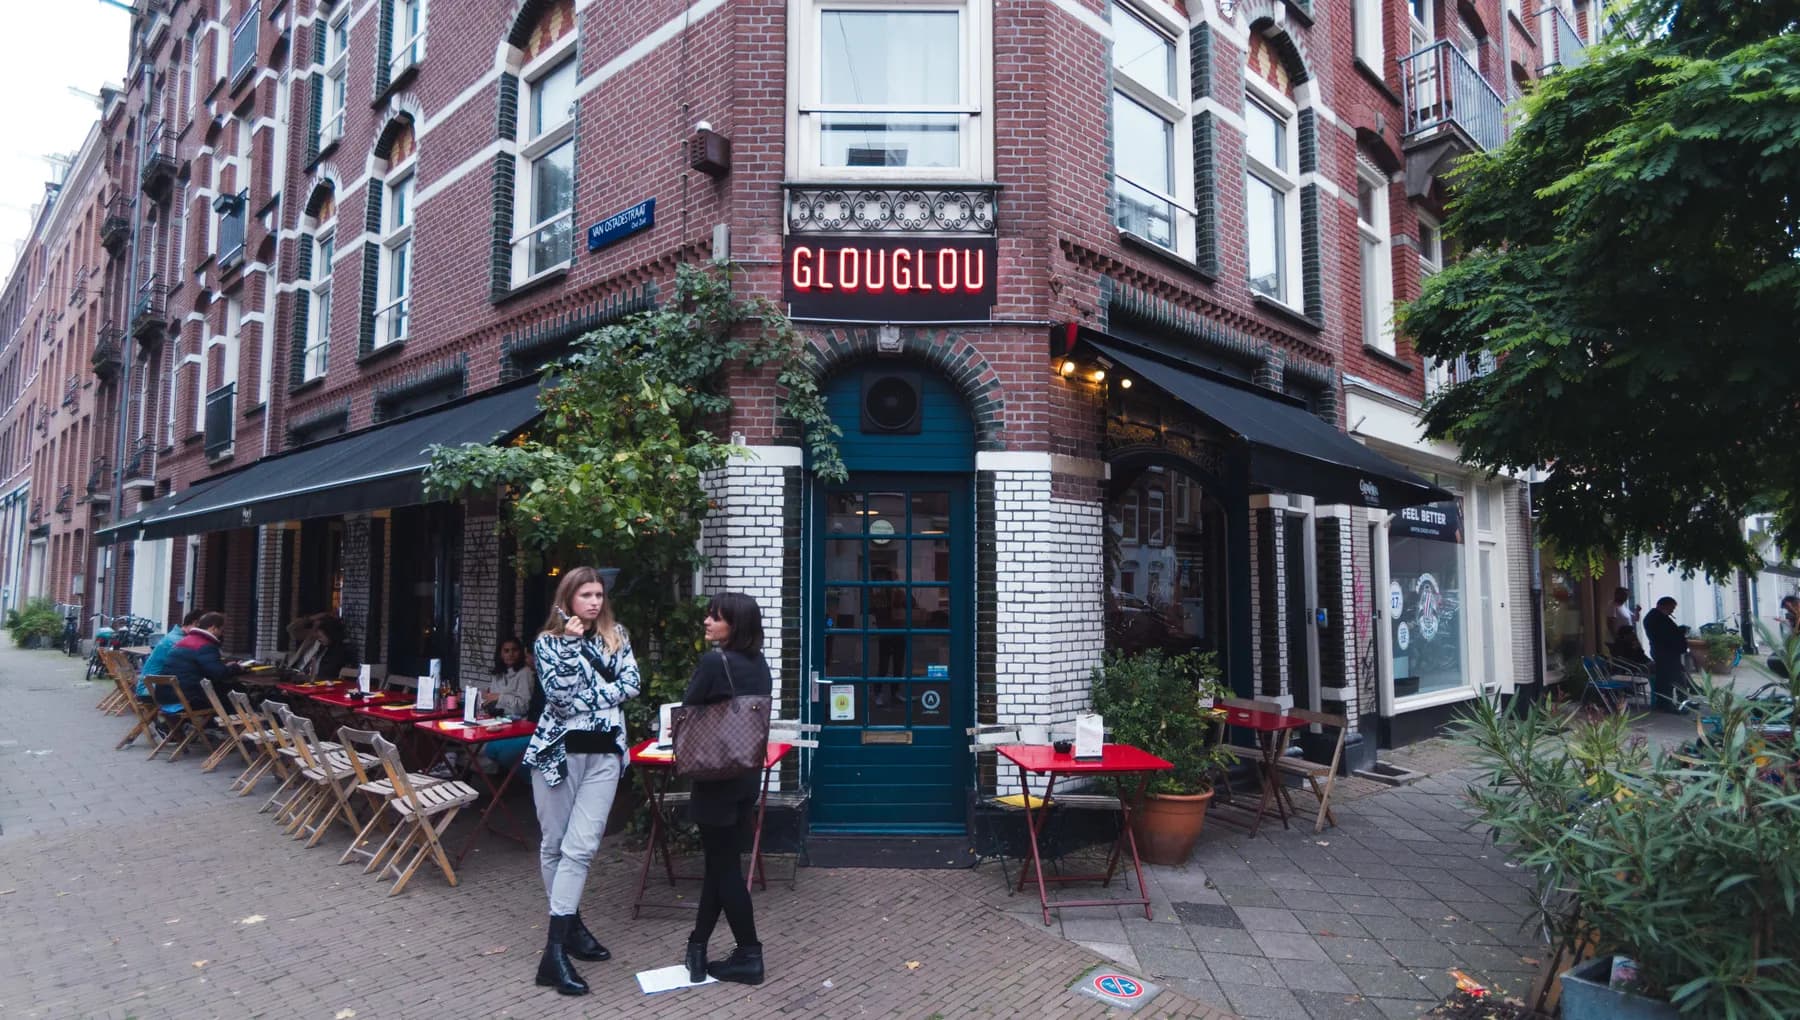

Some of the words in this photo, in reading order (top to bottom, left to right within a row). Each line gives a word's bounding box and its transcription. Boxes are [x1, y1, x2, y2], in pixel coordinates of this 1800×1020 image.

[592, 223, 604, 238] VAN
[604, 203, 647, 232] OSTADESTRAAT
[792, 246, 984, 290] GLOUGLOU
[1401, 507, 1420, 521] FEEL
[1421, 509, 1447, 526] BETTER
